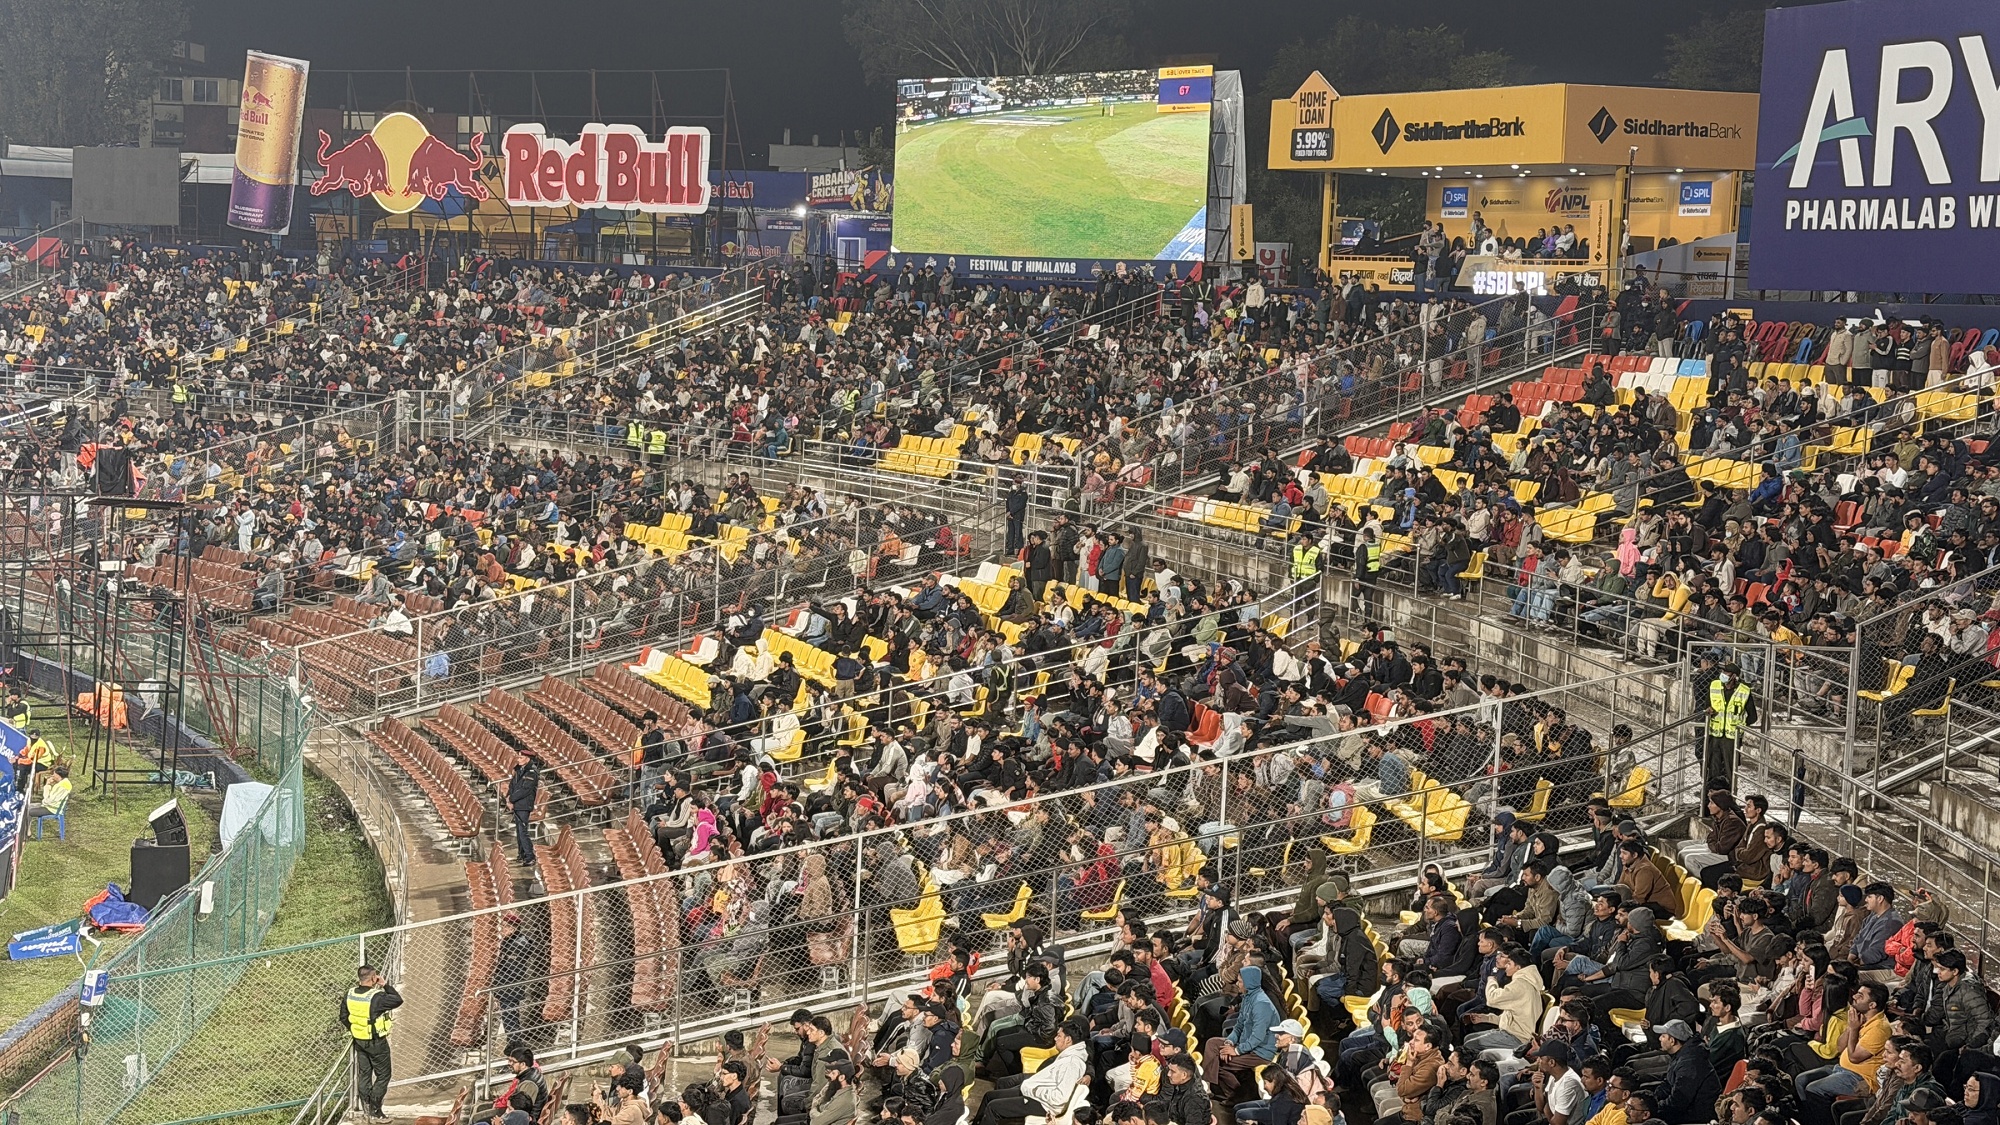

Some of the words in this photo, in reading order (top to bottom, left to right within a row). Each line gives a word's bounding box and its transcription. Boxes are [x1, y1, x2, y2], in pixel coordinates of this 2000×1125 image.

[1179, 85, 1190, 96] 67
[1300, 91, 1327, 108] HOME
[250, 111, 269, 126] Bull
[1300, 108, 1325, 125] LOAN
[1296, 132, 1326, 149] 5.99%
[505, 132, 602, 203] Red
[603, 132, 705, 206] Bull
[812, 171, 849, 188] BABAAL
[812, 185, 849, 199] CRICKET
[1454, 193, 1467, 202] SPIL
[1693, 188, 1710, 198] SPIL
[1561, 195, 1590, 210] NPL
[1785, 196, 1956, 230] PHARMALAB
[747, 245, 763, 256] Red
[765, 245, 780, 257] Bull
[970, 259, 1008, 271] FESTIVAL
[1012, 261, 1022, 272] OF
[1026, 261, 1076, 274] HIMALAYAS
